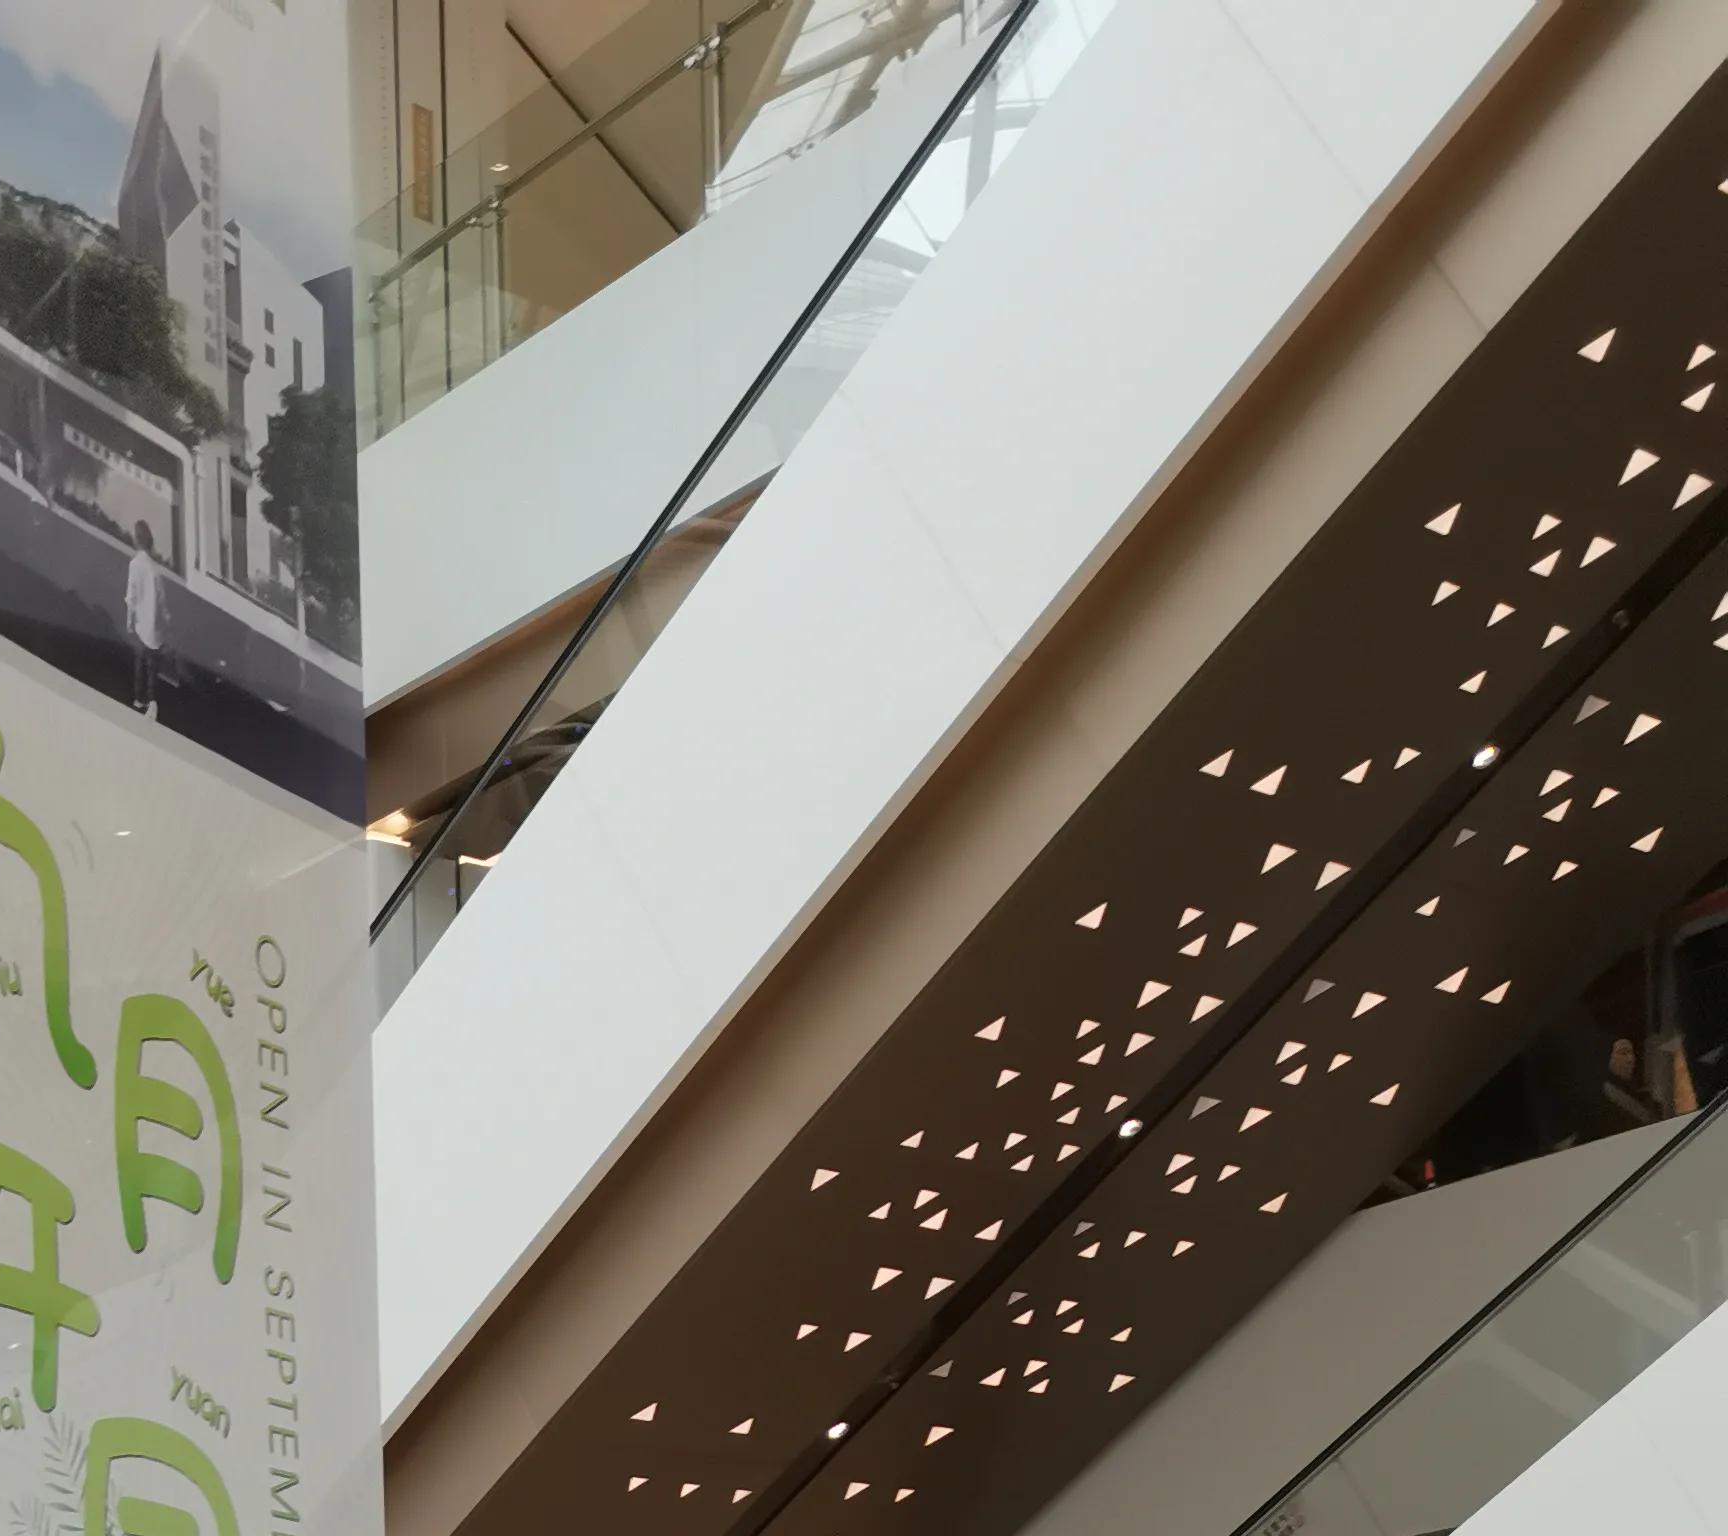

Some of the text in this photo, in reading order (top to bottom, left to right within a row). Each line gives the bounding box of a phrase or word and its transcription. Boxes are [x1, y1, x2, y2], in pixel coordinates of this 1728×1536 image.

[254, 934, 293, 1131] OPEN
[260, 1163, 294, 1233] IN
[170, 1364, 232, 1439] yuan
